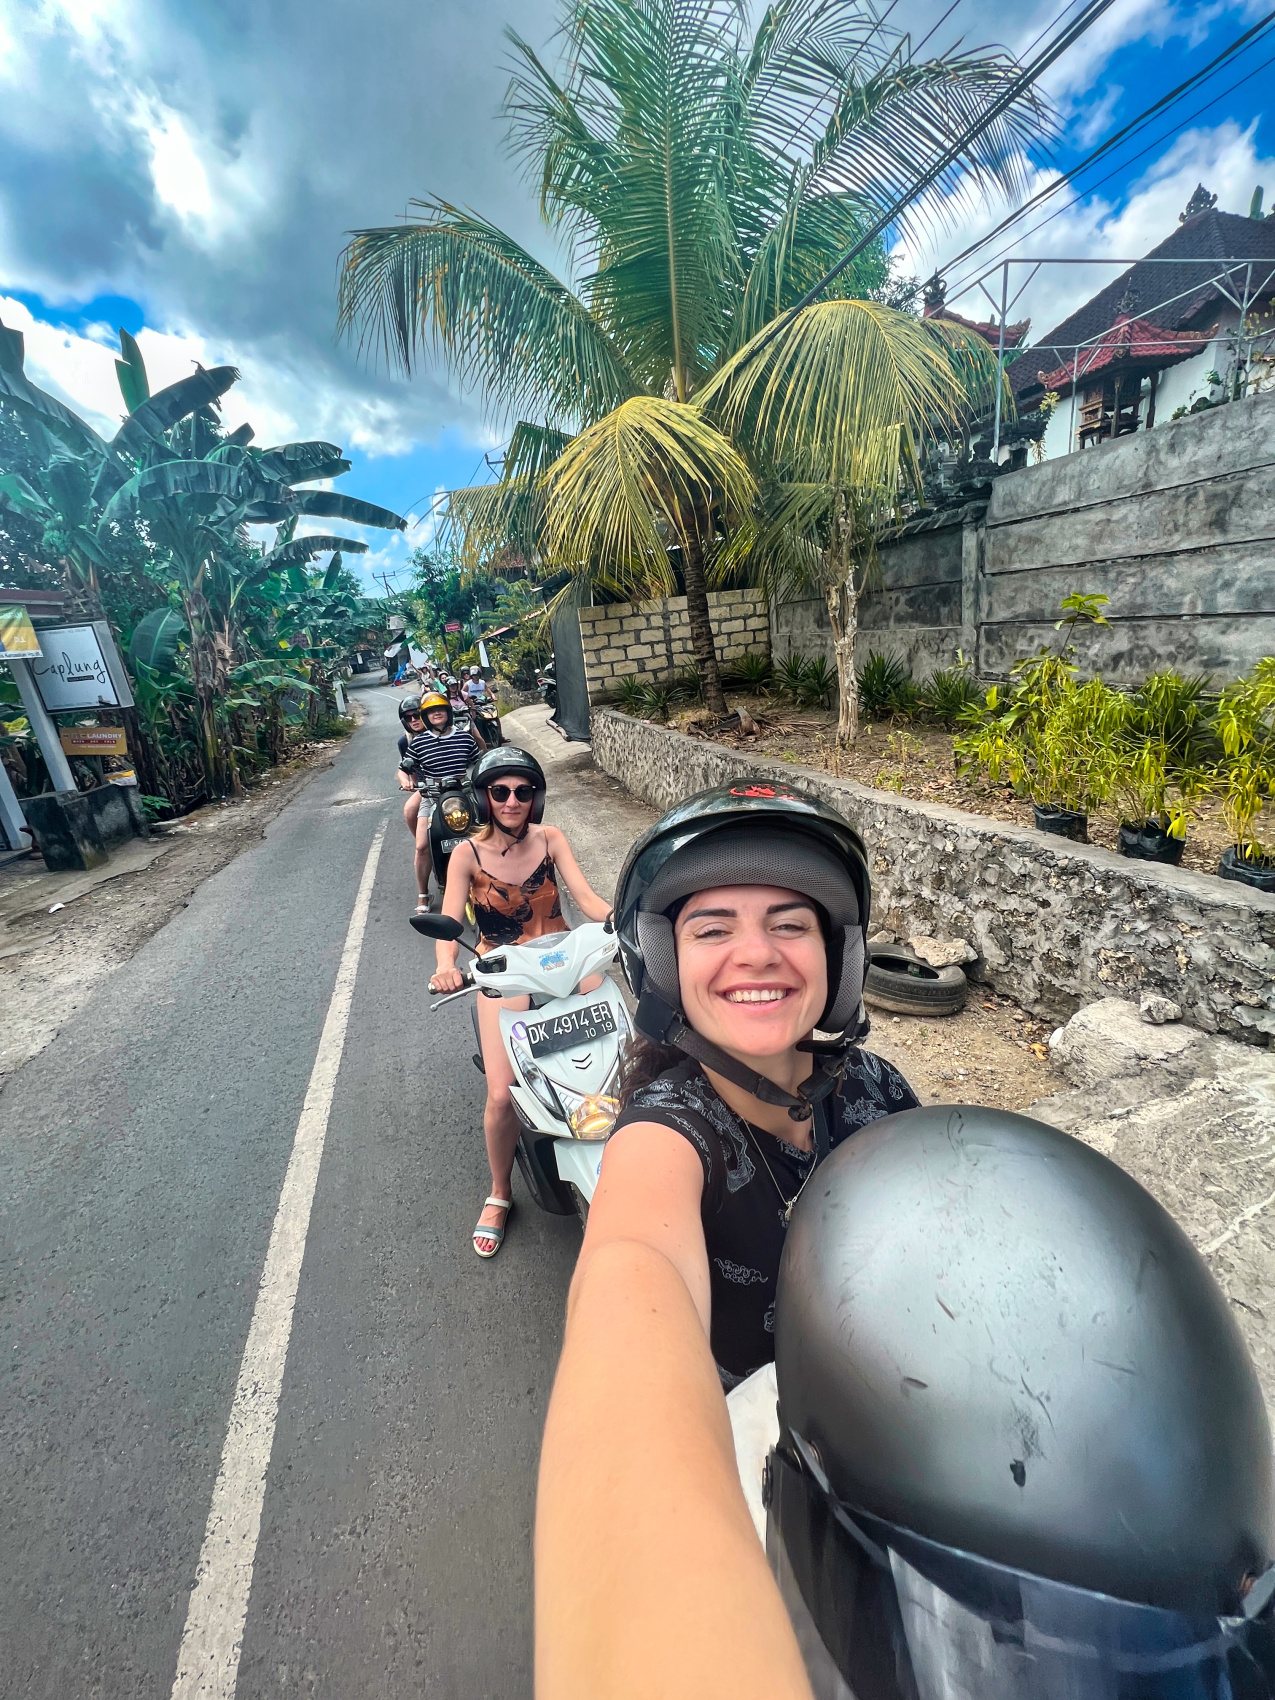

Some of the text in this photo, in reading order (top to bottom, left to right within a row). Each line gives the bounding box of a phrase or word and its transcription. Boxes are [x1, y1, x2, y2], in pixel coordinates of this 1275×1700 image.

[528, 1003, 612, 1045] DK 4914 ER
[585, 1021, 613, 1039] 10 19
